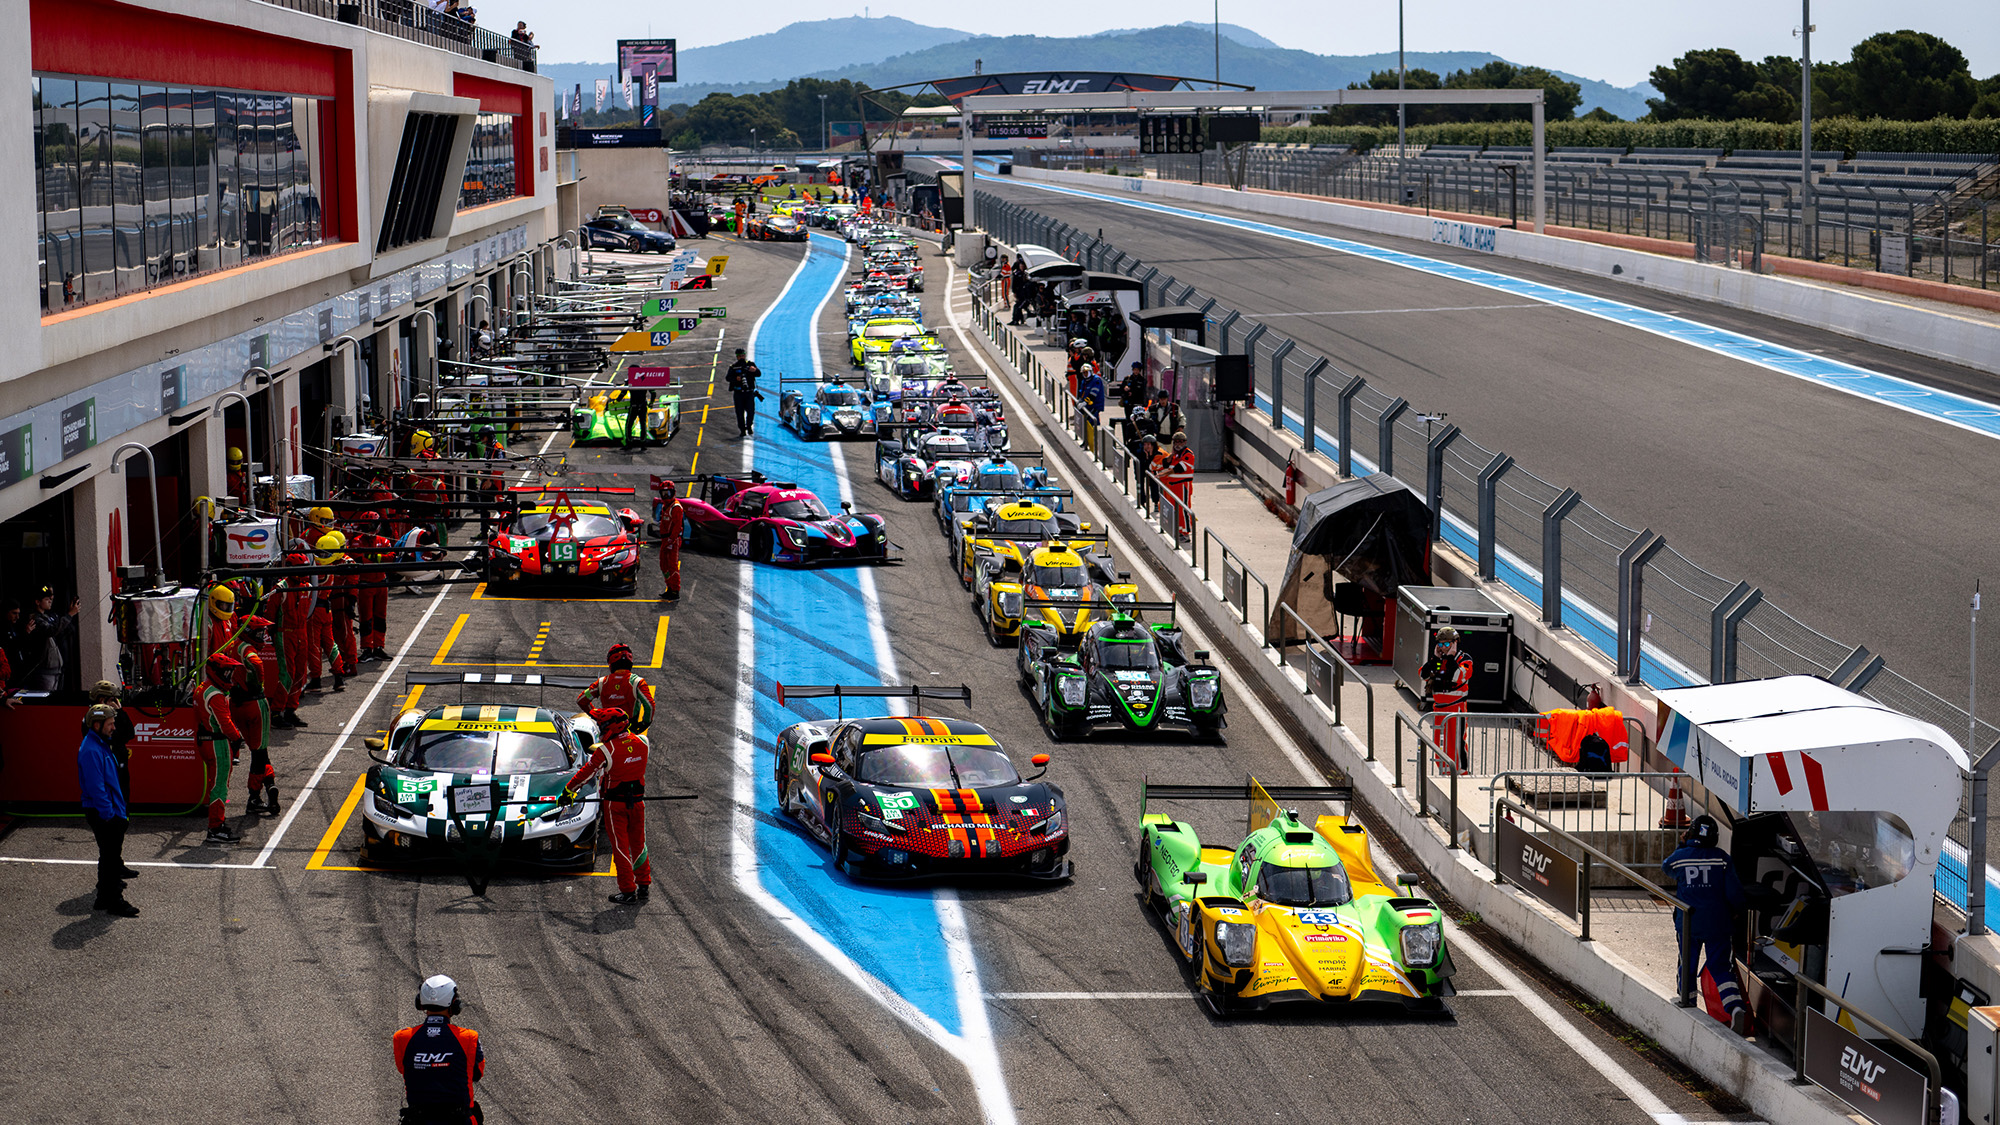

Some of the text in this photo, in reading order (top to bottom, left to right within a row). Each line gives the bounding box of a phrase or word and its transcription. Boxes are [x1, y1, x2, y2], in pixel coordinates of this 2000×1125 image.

[1022, 79, 1091, 94] ELMS
[989, 127, 1019, 135] 11:50:05
[714, 264, 721, 273] 8
[660, 299, 672, 311] 34
[680, 319, 695, 329] 13
[652, 333, 670, 346] 43
[1007, 510, 1046, 518] VIRAGE
[738, 539, 749, 556] 68
[229, 552, 270, 560] TotalEnergies
[454, 721, 519, 731] Ferrari
[155, 728, 195, 737] corse
[901, 735, 964, 745] Ferrari
[792, 747, 806, 772] 50
[401, 780, 433, 793] 55
[882, 797, 914, 809] 50
[373, 811, 398, 824] GOODYEAR
[555, 816, 582, 827] GOODYEAR
[863, 830, 894, 843] GOODYEAR
[1160, 845, 1181, 878] NEO-TEC
[1522, 844, 1552, 873] ELMS
[1685, 866, 1711, 885] PT
[1302, 913, 1338, 924] 43
[1253, 977, 1291, 991] Europol
[1360, 974, 1397, 986] Europol
[413, 1052, 453, 1063] ELMS
[1840, 1045, 1886, 1084] ELMS
[1839, 1077, 1853, 1092] SERIES
[1839, 1070, 1880, 1100] EUROPEAN LE MANS
